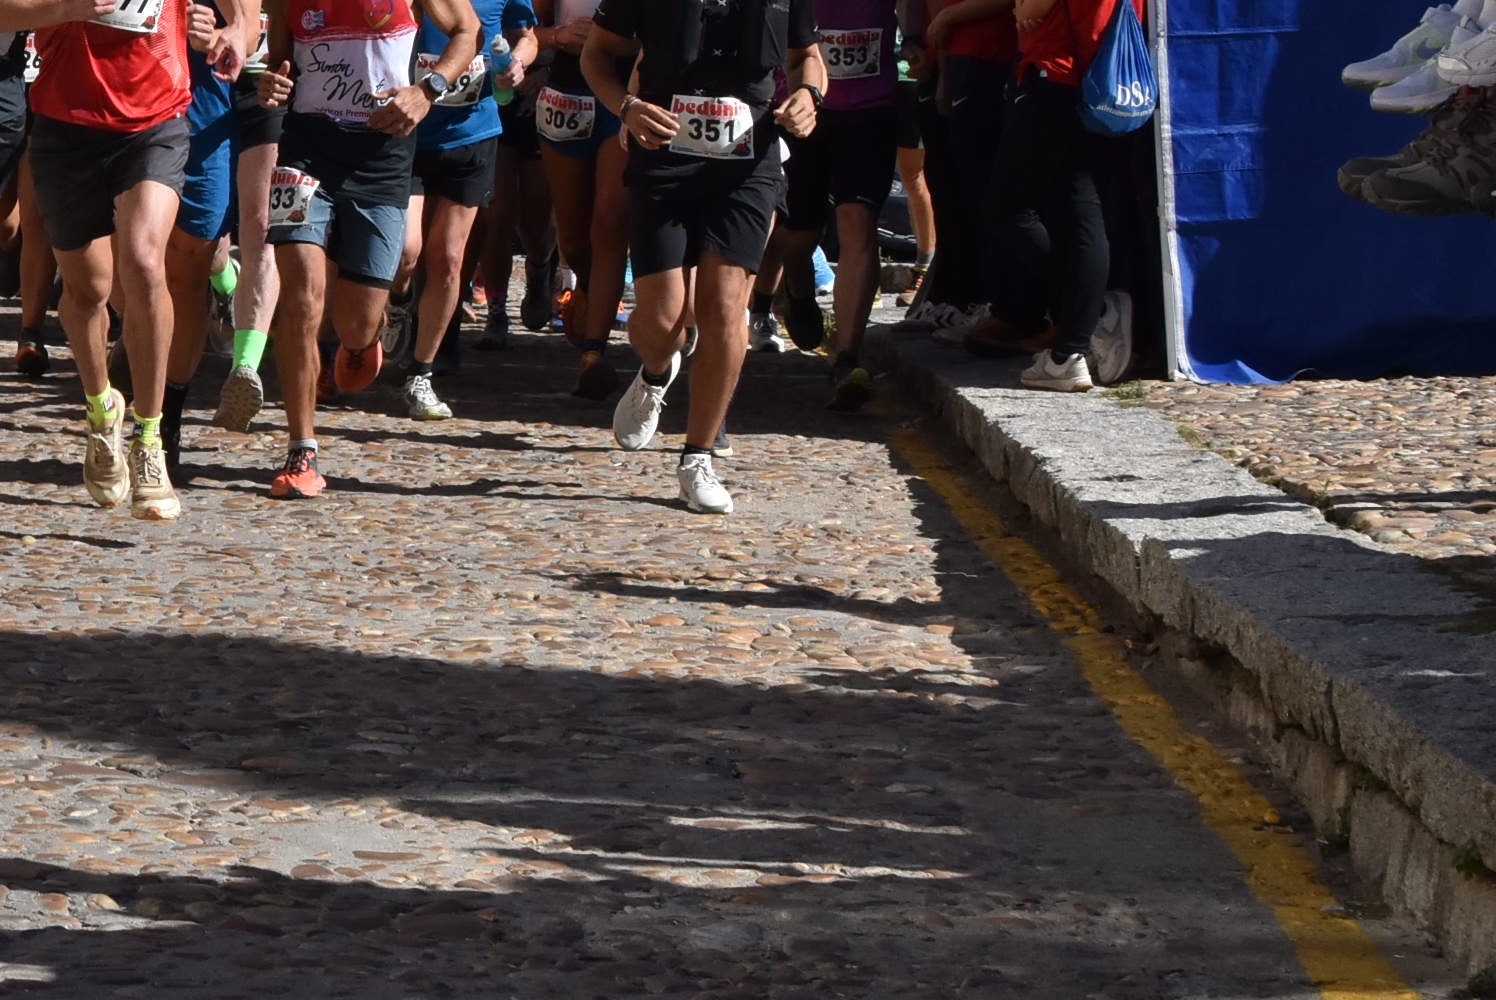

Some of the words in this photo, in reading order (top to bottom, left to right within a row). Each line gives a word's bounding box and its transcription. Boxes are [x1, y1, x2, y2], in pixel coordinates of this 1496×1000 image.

[307, 43, 355, 77] Simón
[828, 46, 867, 67] 353
[545, 107, 580, 130] 306
[687, 117, 734, 143] 351
